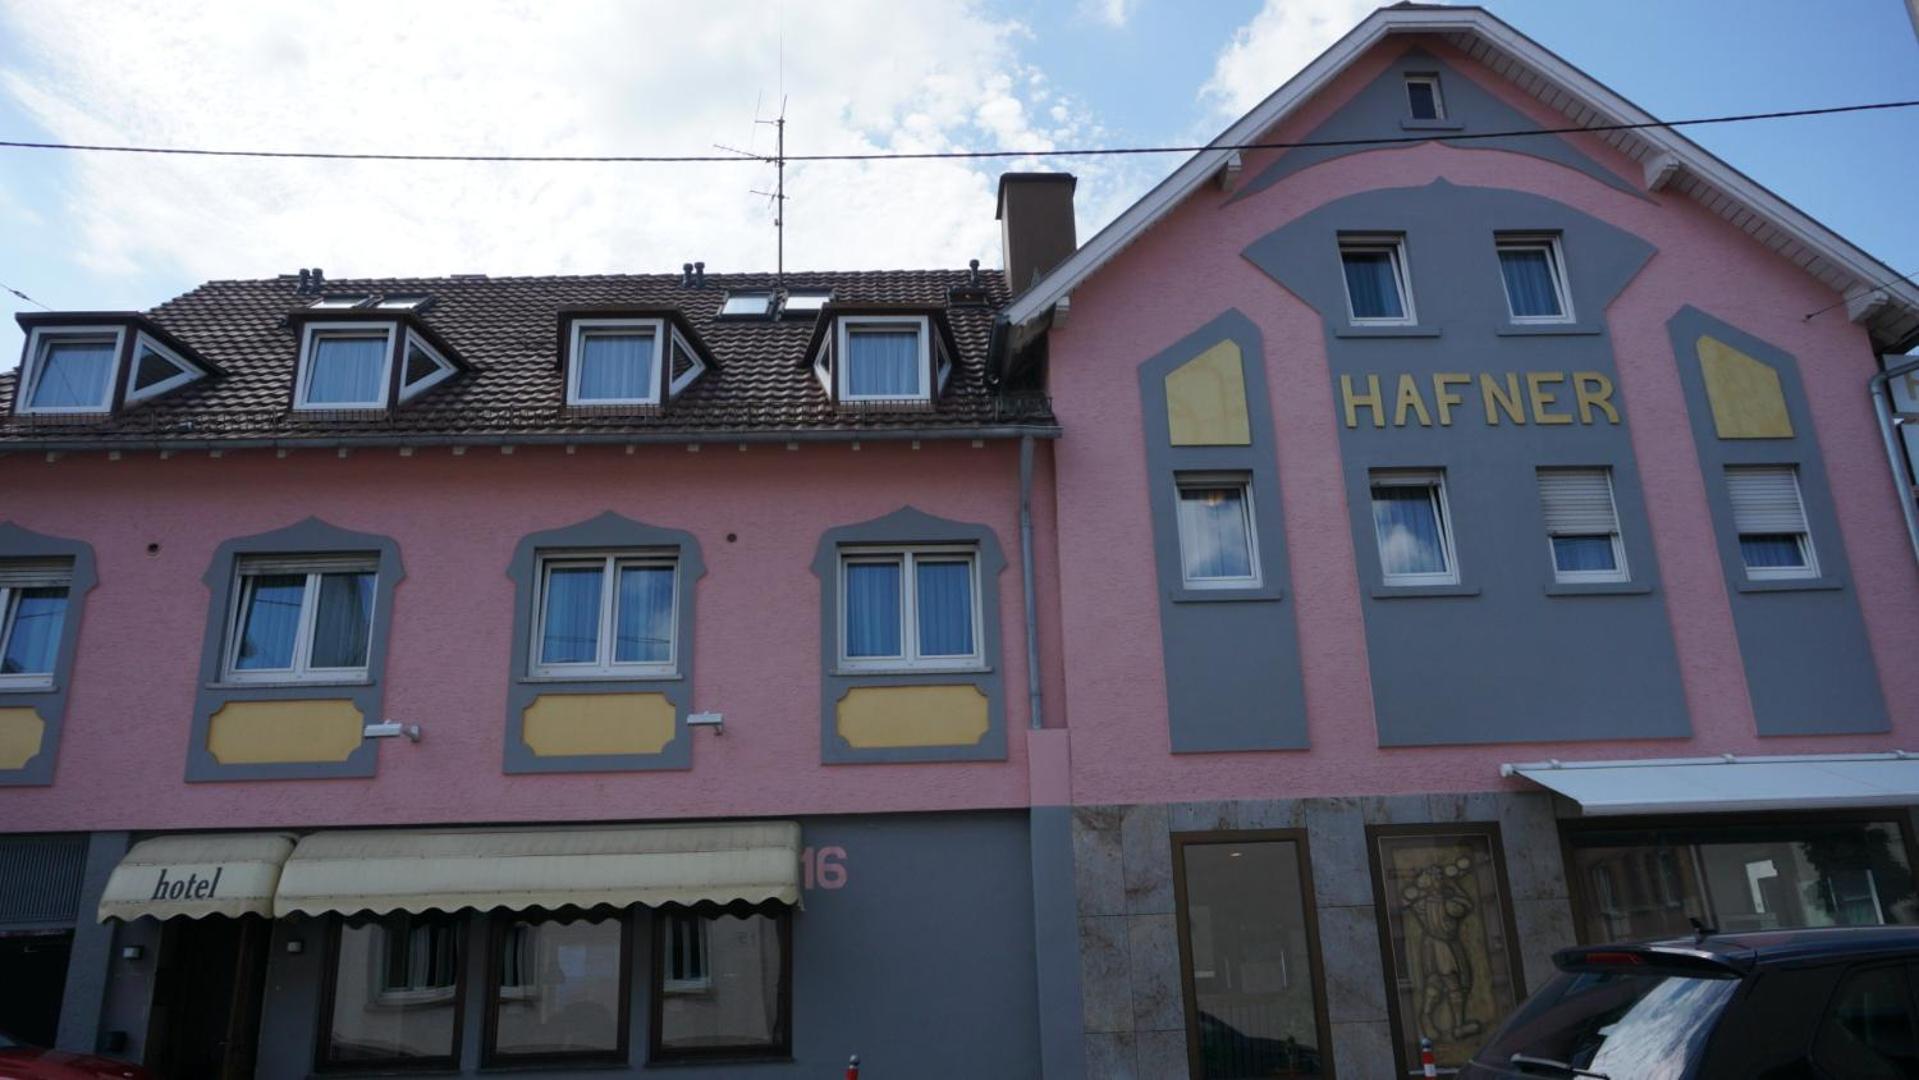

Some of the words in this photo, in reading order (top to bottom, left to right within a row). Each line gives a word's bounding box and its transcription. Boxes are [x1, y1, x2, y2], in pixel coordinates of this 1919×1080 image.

[1340, 372, 1620, 427] HAFNER
[151, 866, 223, 900] hotel
[801, 845, 848, 890] 16
